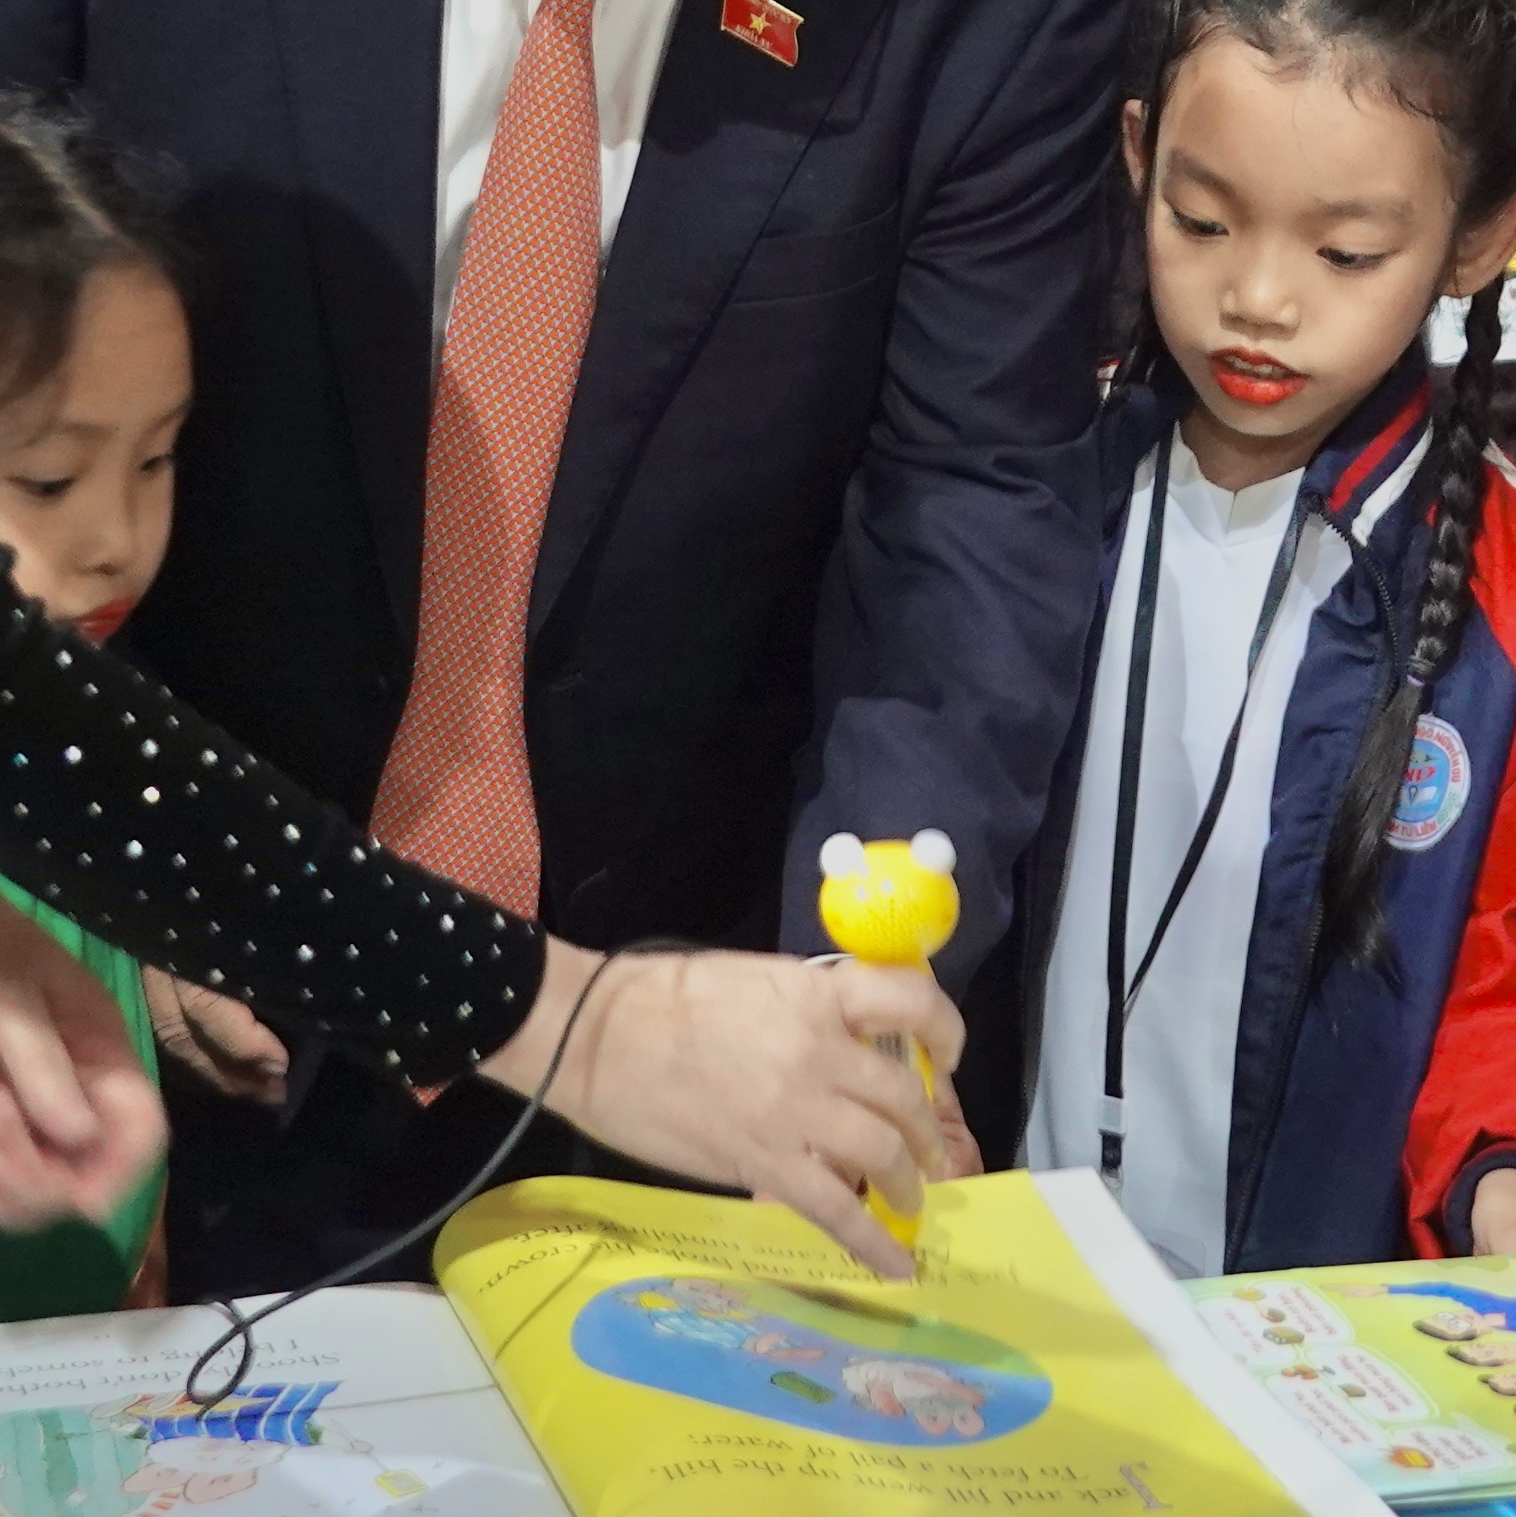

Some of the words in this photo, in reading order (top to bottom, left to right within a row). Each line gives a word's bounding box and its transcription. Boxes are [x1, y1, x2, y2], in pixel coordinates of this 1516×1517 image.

[643, 1246, 732, 1272] broke
[752, 1246, 827, 1261] came
[742, 1260, 795, 1281] and
[115, 1355, 149, 1366] to
[99, 1369, 183, 1388] don't
[805, 1443, 835, 1461] of
[848, 1452, 905, 1472] pail
[650, 1457, 721, 1482] hill,
[732, 1458, 785, 1478] the
[799, 1463, 840, 1481] up
[919, 1463, 933, 1474] a
[948, 1463, 1029, 1483] fetch
[1040, 1464, 1087, 1482] To
[853, 1473, 931, 1496] went
[1073, 1461, 1171, 1512] Jack
[946, 1485, 989, 1505] Jill
[1004, 1488, 1062, 1506] and
